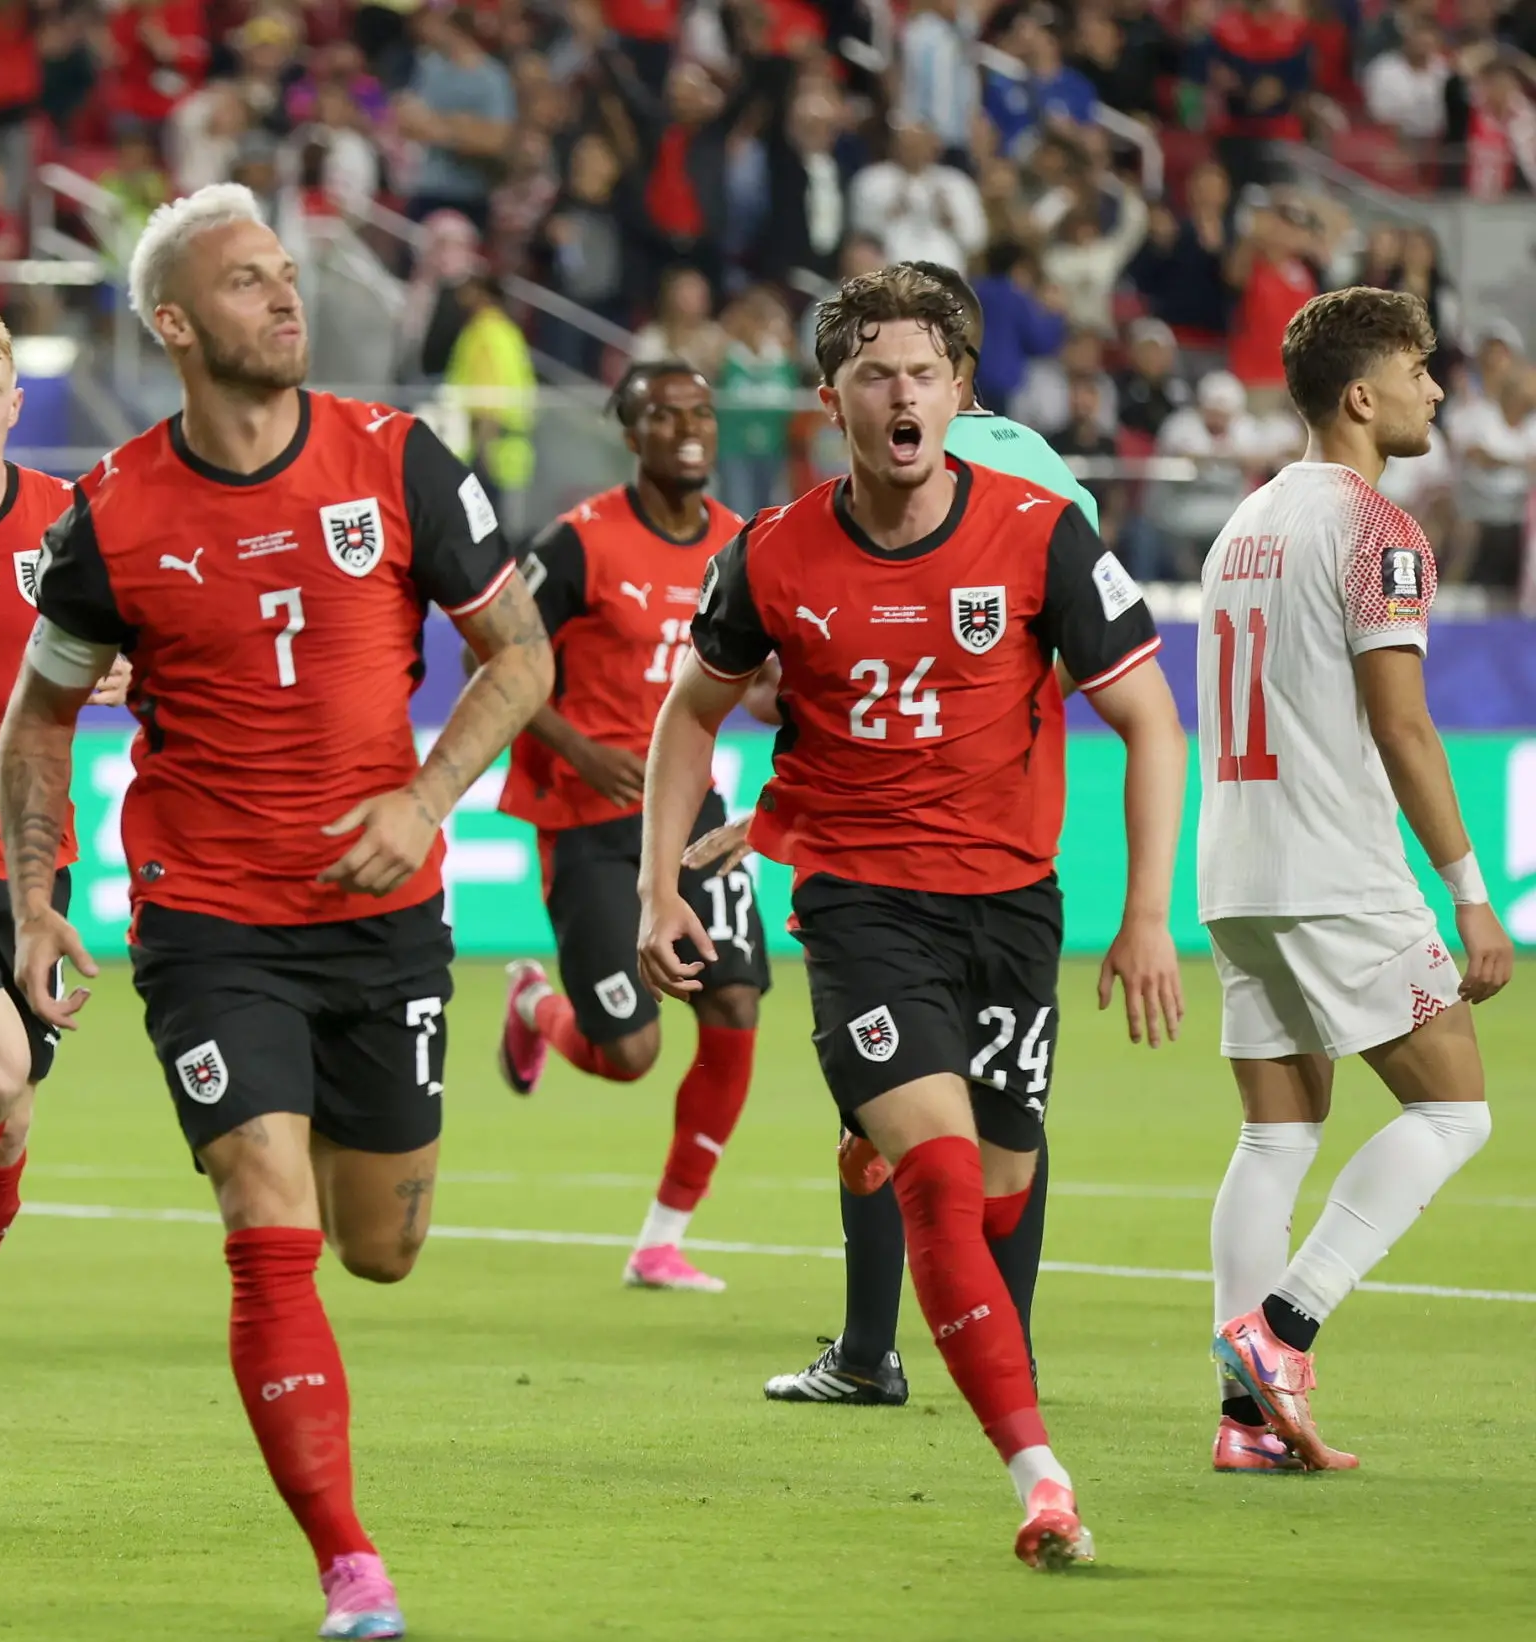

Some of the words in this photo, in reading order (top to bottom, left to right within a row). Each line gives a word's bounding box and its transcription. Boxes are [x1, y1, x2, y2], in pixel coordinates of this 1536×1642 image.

[1222, 535, 1288, 581] ODEH
[259, 587, 306, 688] 7
[850, 656, 943, 739] 24
[1214, 608, 1279, 782] 11
[406, 996, 442, 1086] 7
[969, 1005, 1053, 1094] 24
